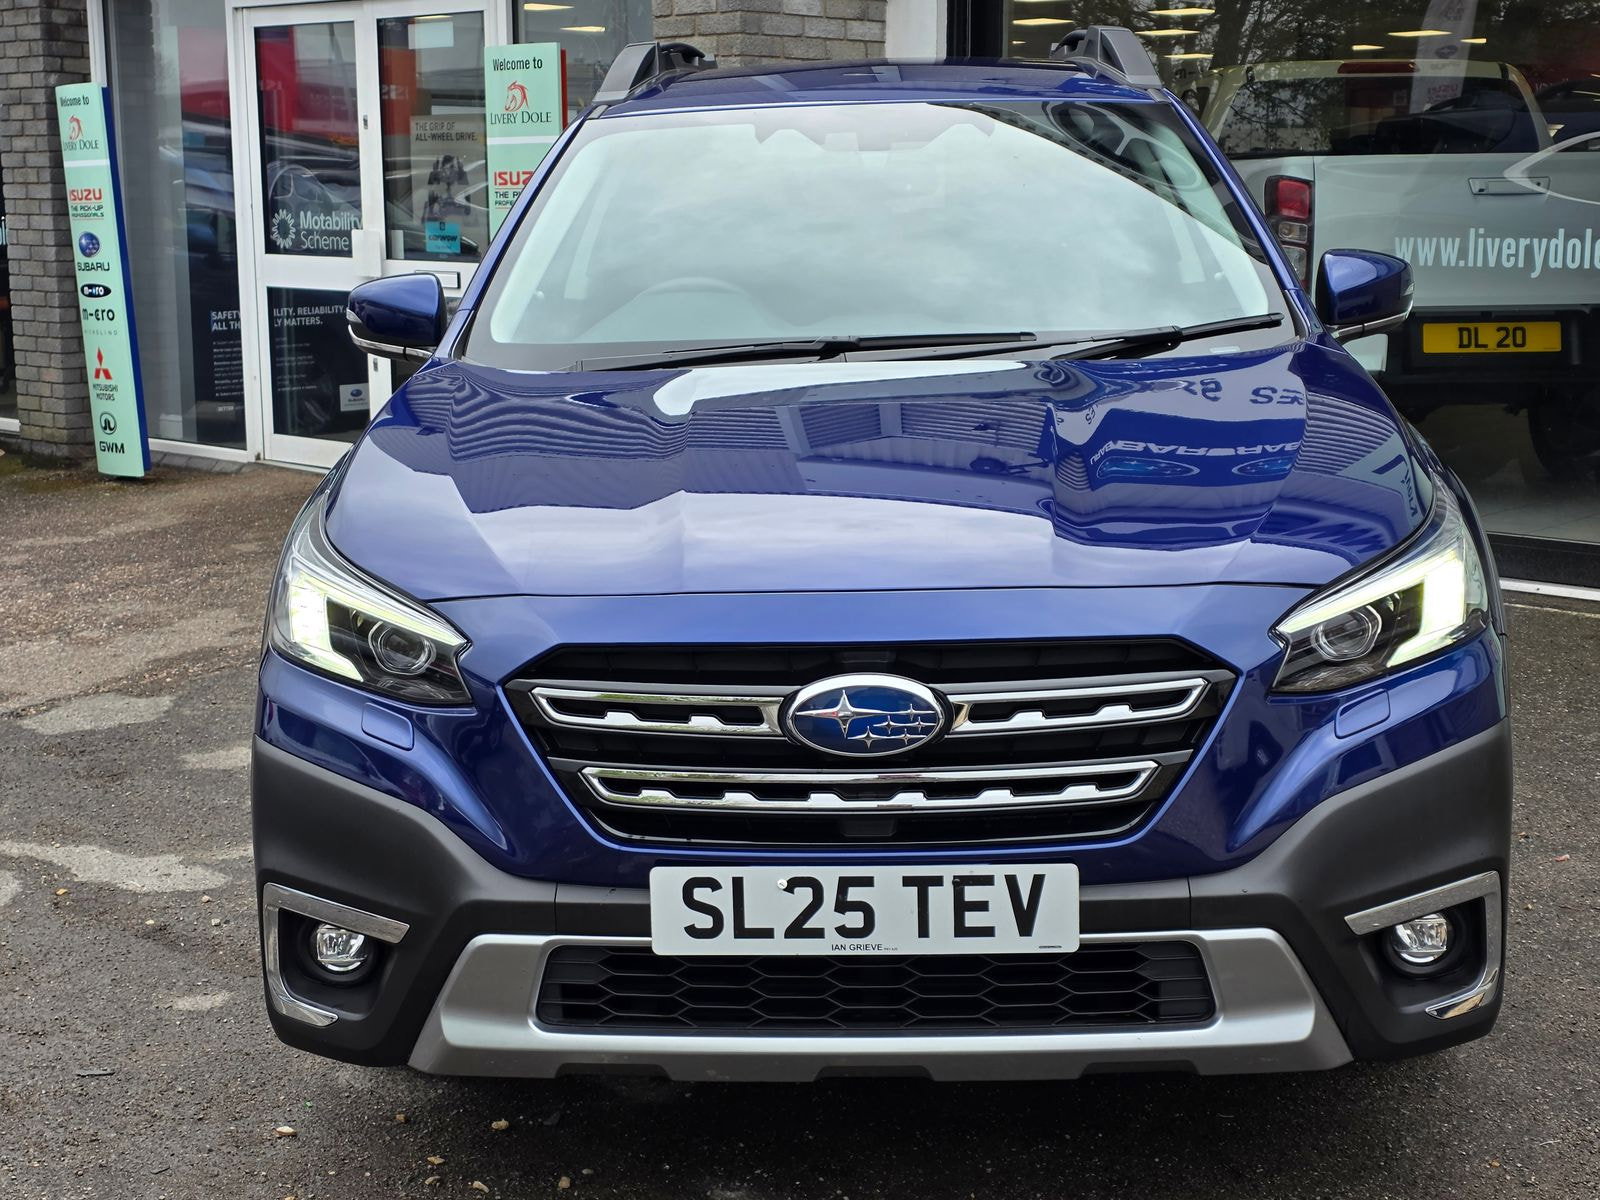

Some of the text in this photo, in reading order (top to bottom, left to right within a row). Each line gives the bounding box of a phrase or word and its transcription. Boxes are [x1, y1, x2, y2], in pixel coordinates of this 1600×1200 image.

[492, 57, 543, 71] Welcome to
[83, 95, 90, 105] to
[490, 111, 552, 125] LIVERY DOLE
[415, 121, 456, 131] THE GRIP OF
[415, 132, 455, 141] ALL-WHEEL
[80, 139, 99, 150] DOLE
[69, 188, 103, 201] ISUZU
[495, 191, 510, 199] THE
[301, 231, 349, 250] Scheme
[77, 262, 110, 272] SUBARU
[297, 305, 346, 315] RELIABILITY.
[212, 321, 228, 331] ALL
[284, 317, 323, 327] MATTERS.
[1457, 326, 1527, 348] DL 20
[99, 441, 125, 454] GWM
[682, 874, 1047, 939] SL25 TEV
[849, 943, 883, 951] GRIEVE
